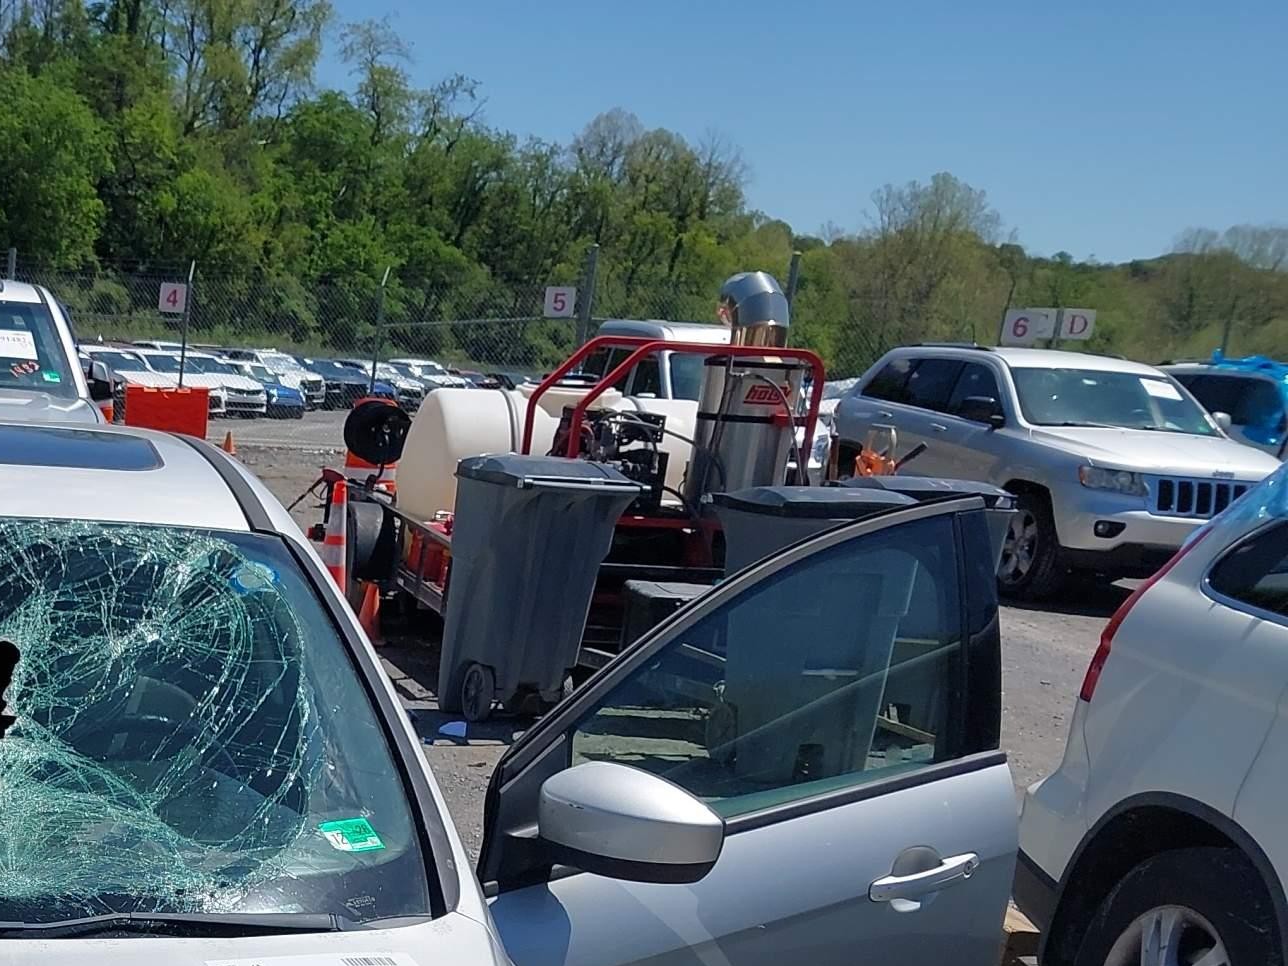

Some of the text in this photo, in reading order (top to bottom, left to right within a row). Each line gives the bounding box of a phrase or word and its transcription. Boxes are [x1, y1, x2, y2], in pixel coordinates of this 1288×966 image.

[166, 289, 178, 307] 4
[553, 293, 567, 312] 5
[1012, 316, 1030, 338] 6
[1069, 314, 1089, 335] D
